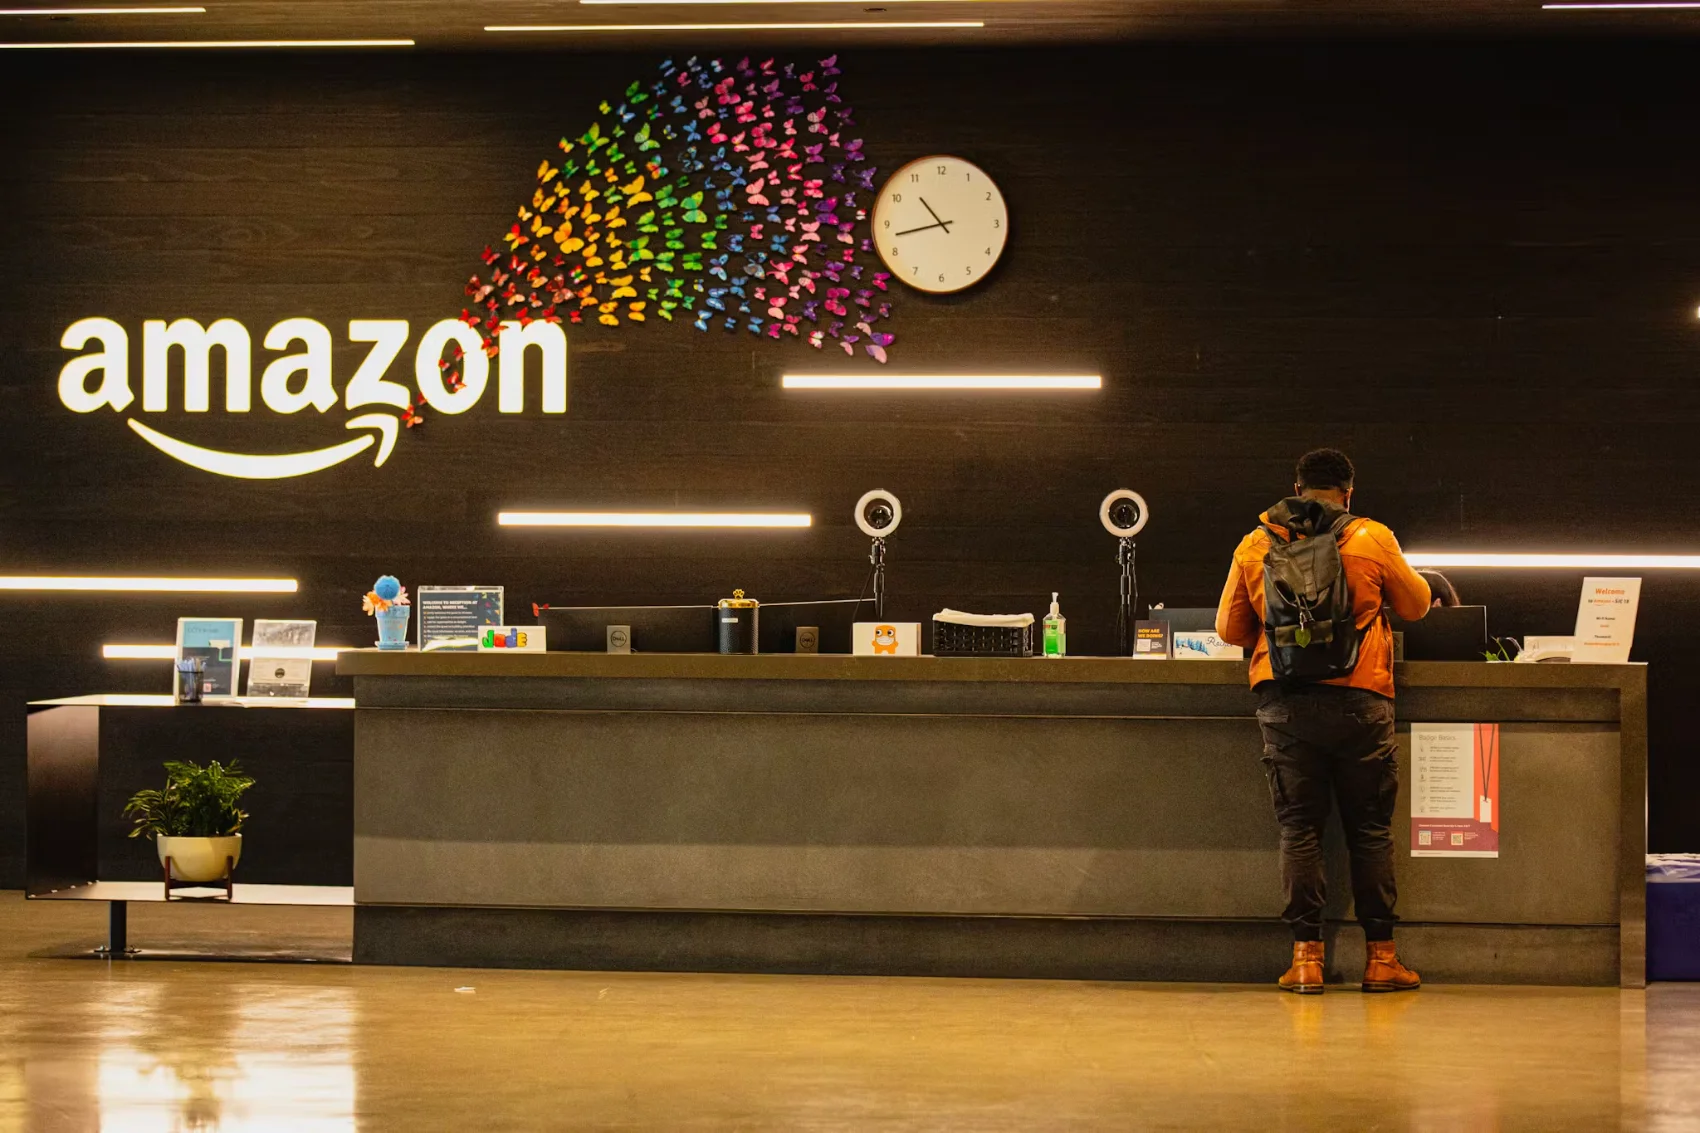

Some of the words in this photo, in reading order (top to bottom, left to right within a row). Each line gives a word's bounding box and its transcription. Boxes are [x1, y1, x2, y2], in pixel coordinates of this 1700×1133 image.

[937, 166, 946, 175] 12
[911, 174, 919, 183] 11
[966, 173, 970, 182] 1
[892, 194, 901, 203] 10
[985, 192, 991, 201] 2
[884, 220, 890, 228] 9
[994, 220, 999, 228] 3
[892, 248, 898, 256] 8
[985, 247, 991, 256] 4
[912, 267, 918, 275] 7
[965, 266, 971, 275] 5
[938, 273, 944, 282] 6
[58, 317, 567, 414] amazon
